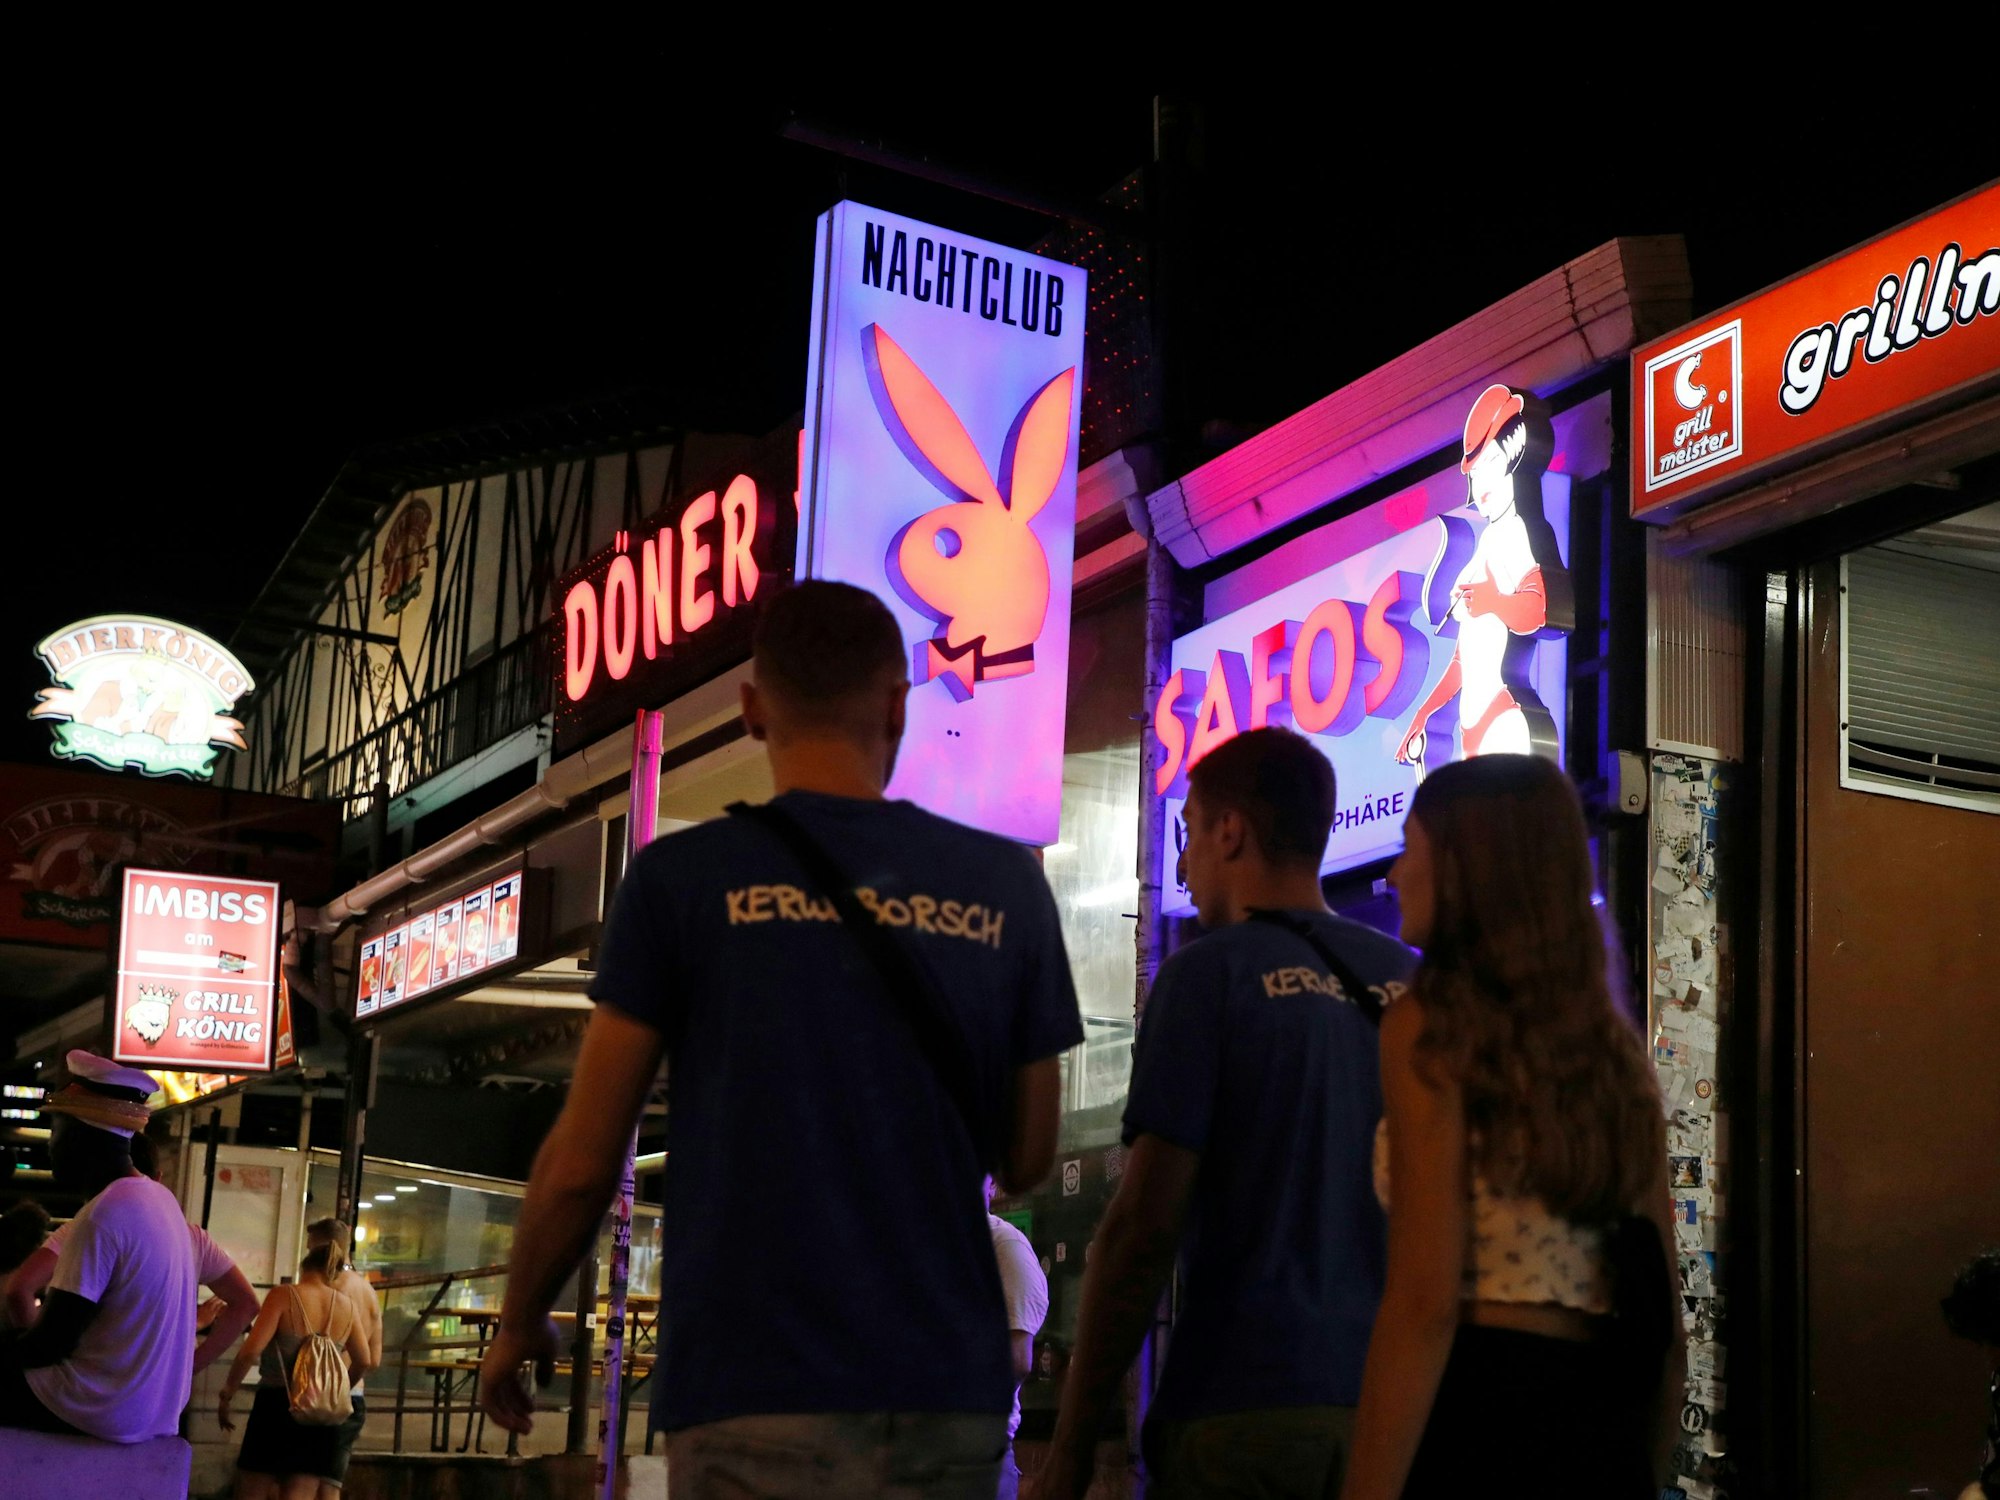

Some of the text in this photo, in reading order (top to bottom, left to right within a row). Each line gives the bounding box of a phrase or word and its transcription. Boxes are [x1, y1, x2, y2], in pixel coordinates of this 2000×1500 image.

[861, 221, 1065, 338] NACHTCLUB
[1673, 405, 1714, 449] grill
[1658, 430, 1729, 474] meister
[564, 473, 760, 702] DÖNER
[51, 625, 244, 696] BIERKÖNIG
[1154, 569, 1405, 797] SAFOS
[1332, 791, 1404, 835] PHÄRE
[133, 883, 268, 926] IMBISS
[184, 932, 214, 947] am
[183, 990, 259, 1015] GRILL
[175, 1014, 263, 1043] KÖNIG
